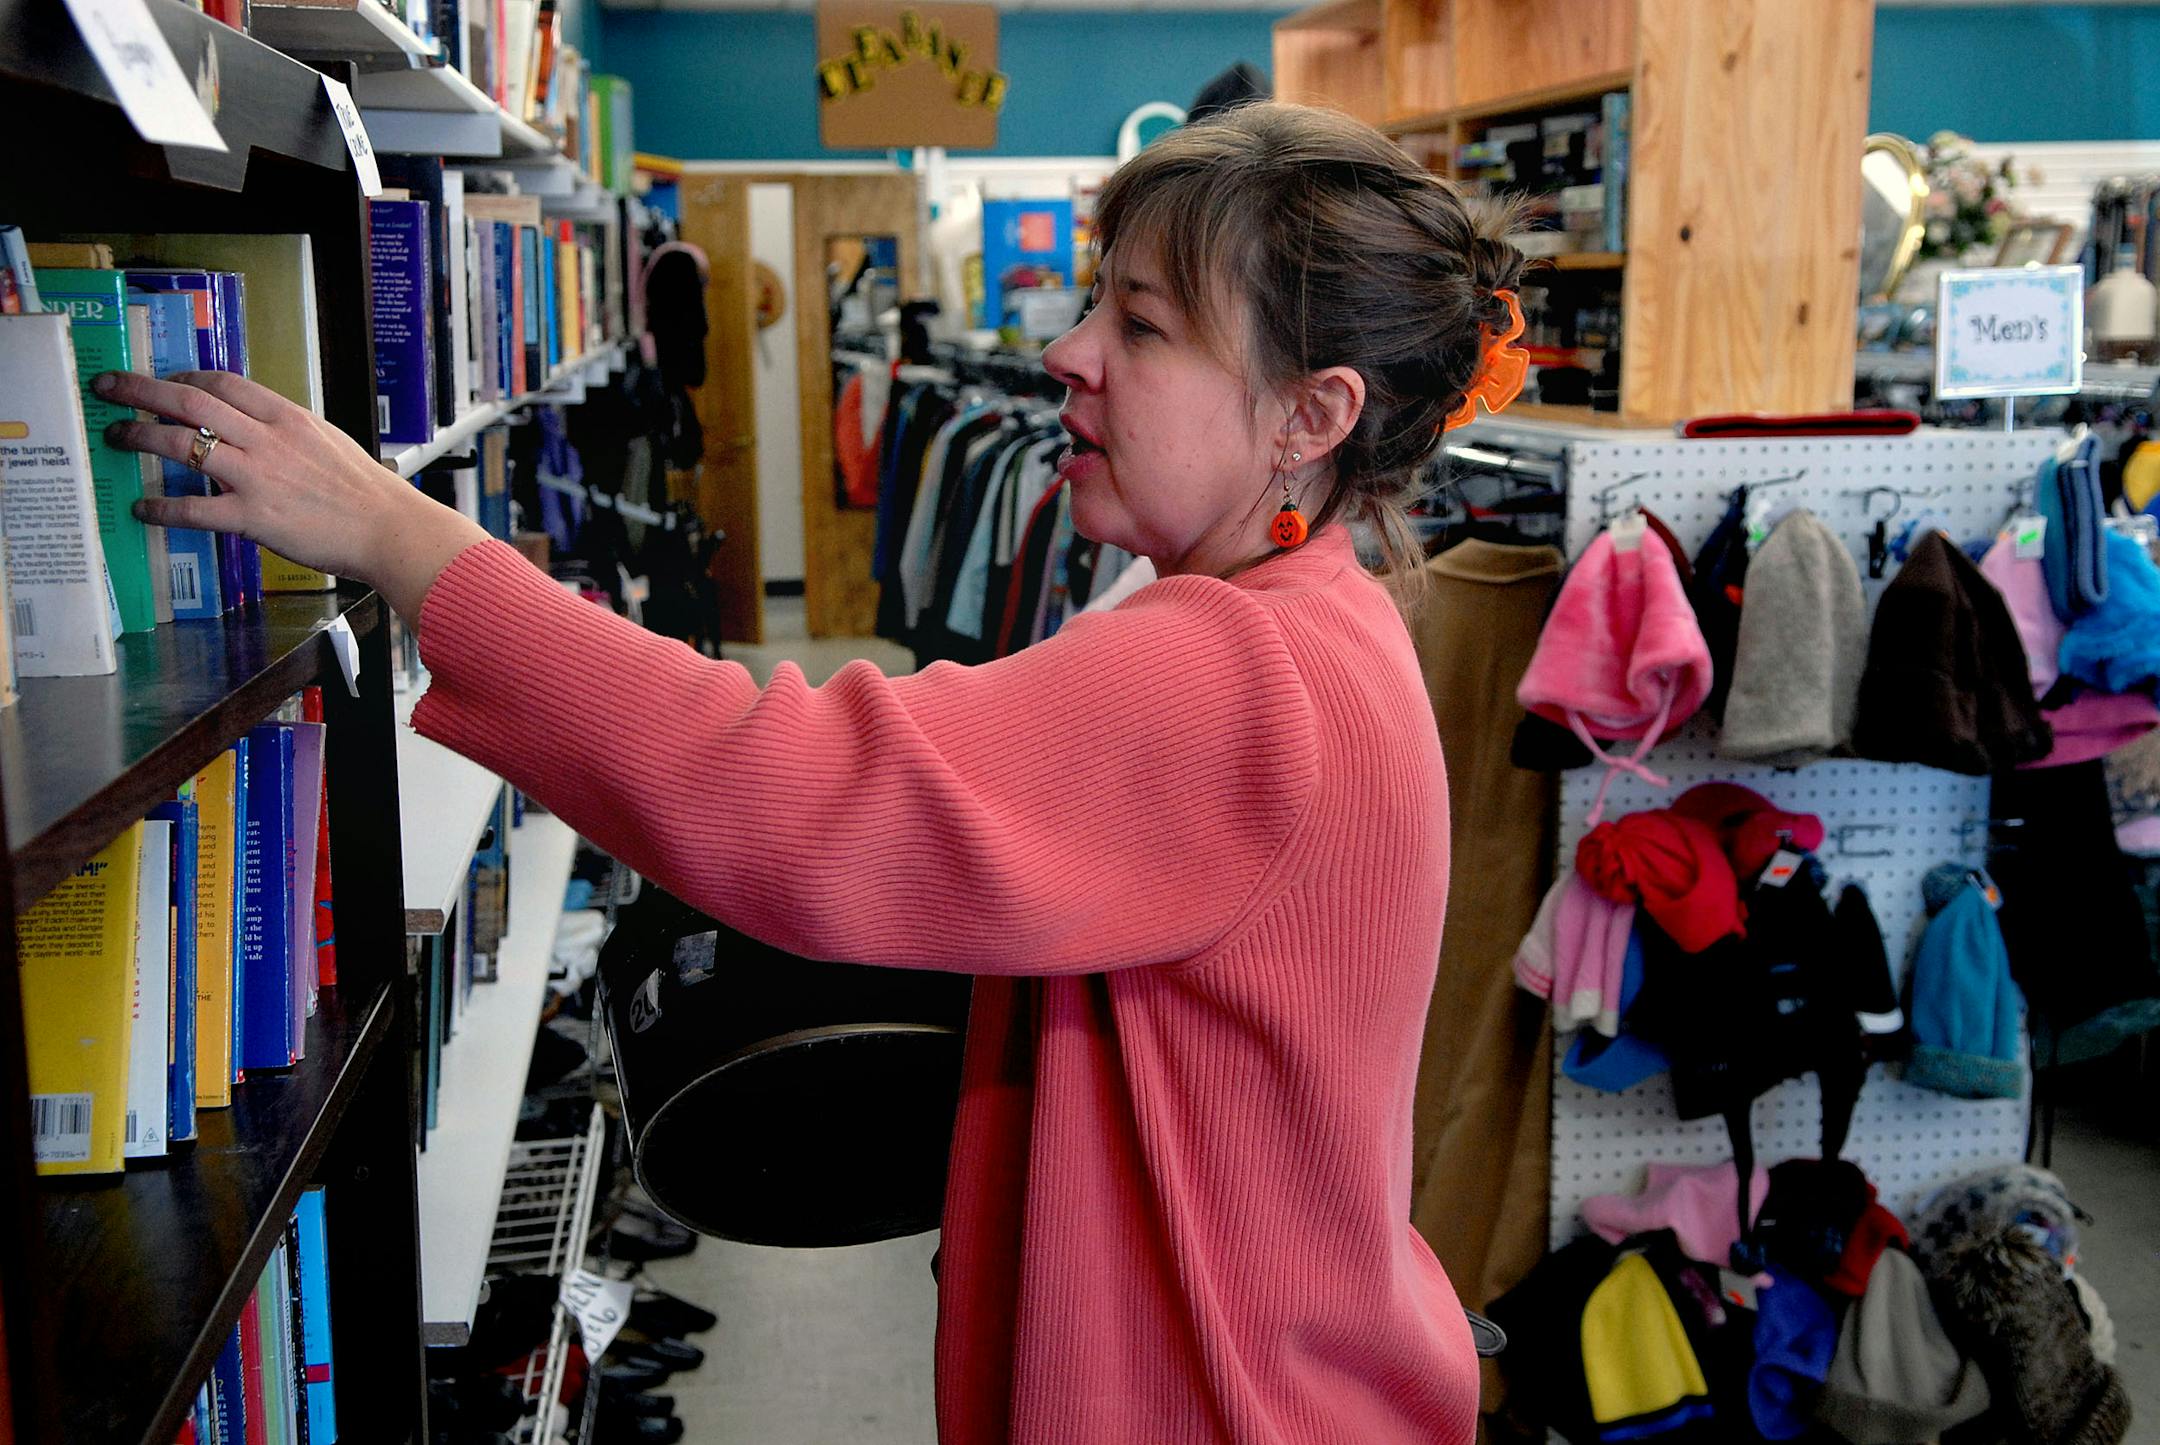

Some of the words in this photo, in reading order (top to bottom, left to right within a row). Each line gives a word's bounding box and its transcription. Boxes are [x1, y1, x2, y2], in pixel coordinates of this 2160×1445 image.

[1969, 314, 2048, 344] Men's
[22, 445, 64, 456] turning
[8, 458, 38, 469] jewel
[42, 457, 70, 466] heist
